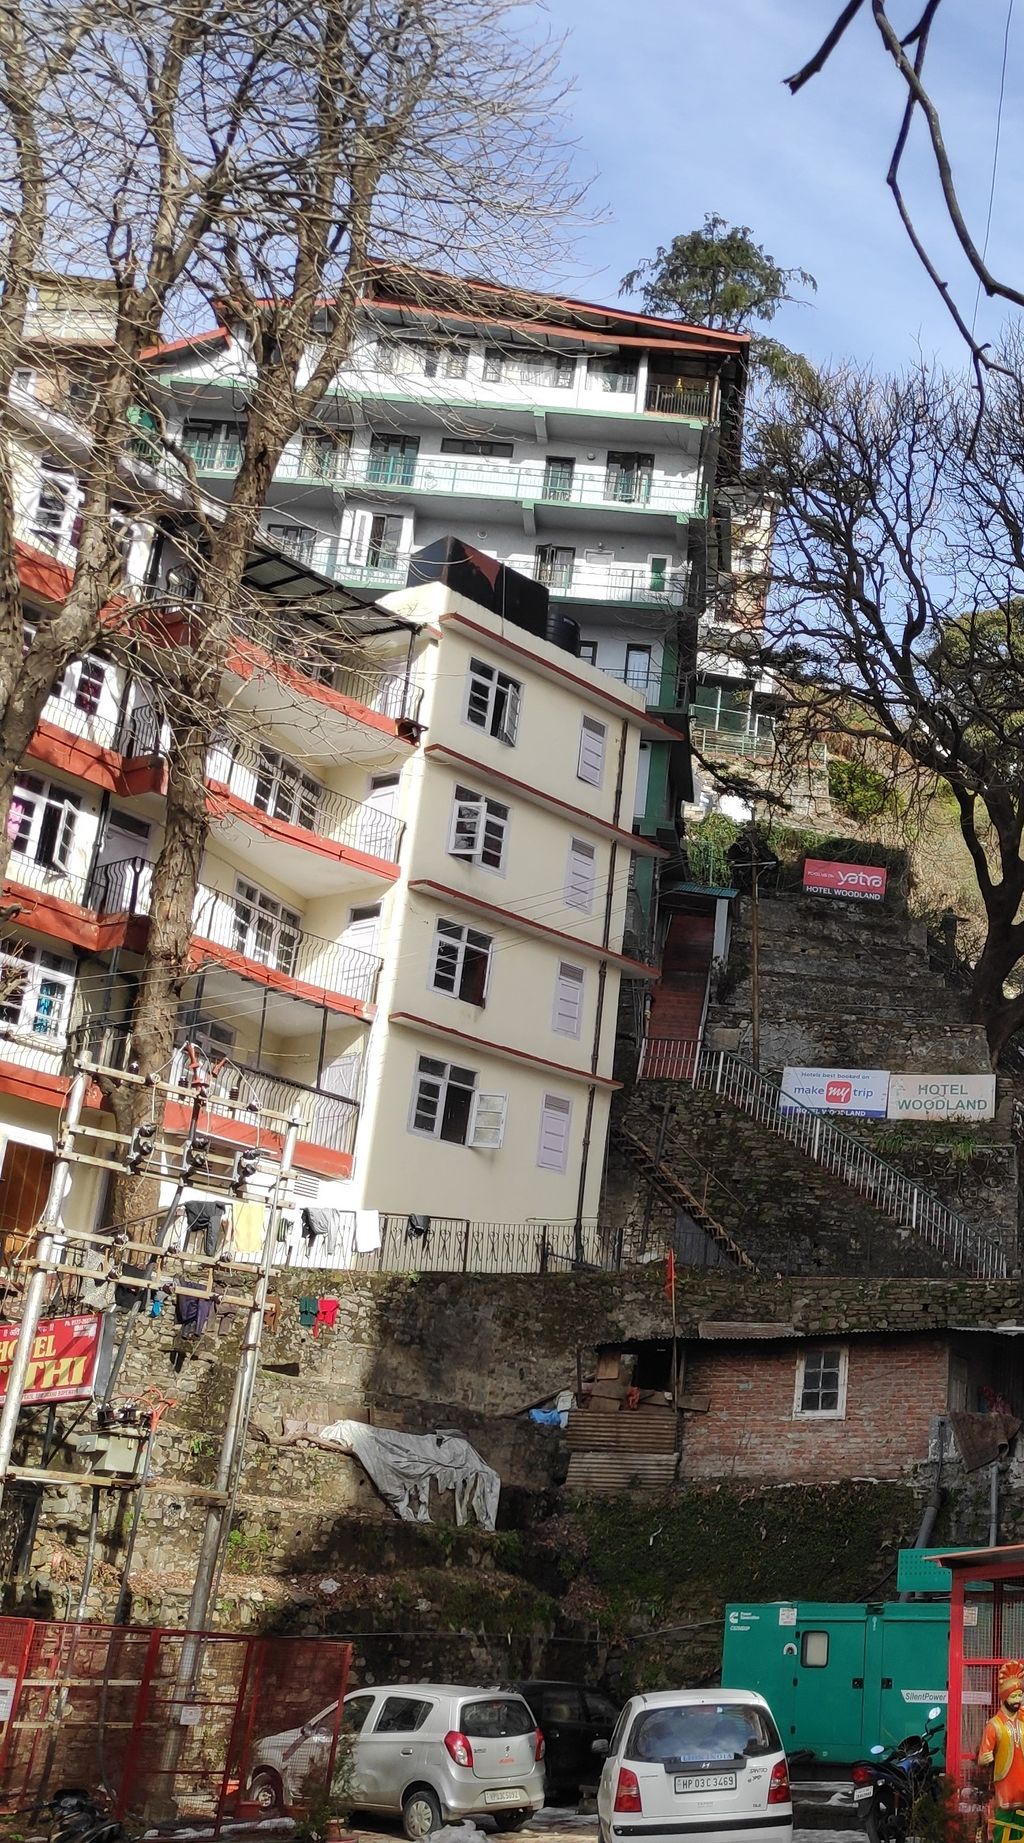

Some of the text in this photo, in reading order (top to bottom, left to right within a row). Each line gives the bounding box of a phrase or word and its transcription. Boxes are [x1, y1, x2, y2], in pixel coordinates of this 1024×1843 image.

[837, 871, 882, 887] yatra
[806, 886, 881, 900] HOTEL WOODLAND
[918, 1084, 969, 1095] HOTEL
[796, 1107, 820, 1115] HOL
[898, 1099, 988, 1111] WOODLAND
[0, 1334, 57, 1362] HOEL
[0, 1356, 87, 1392] THI
[905, 1692, 947, 1701] SilentPower
[682, 1776, 734, 1790] HP 03 C 3469
